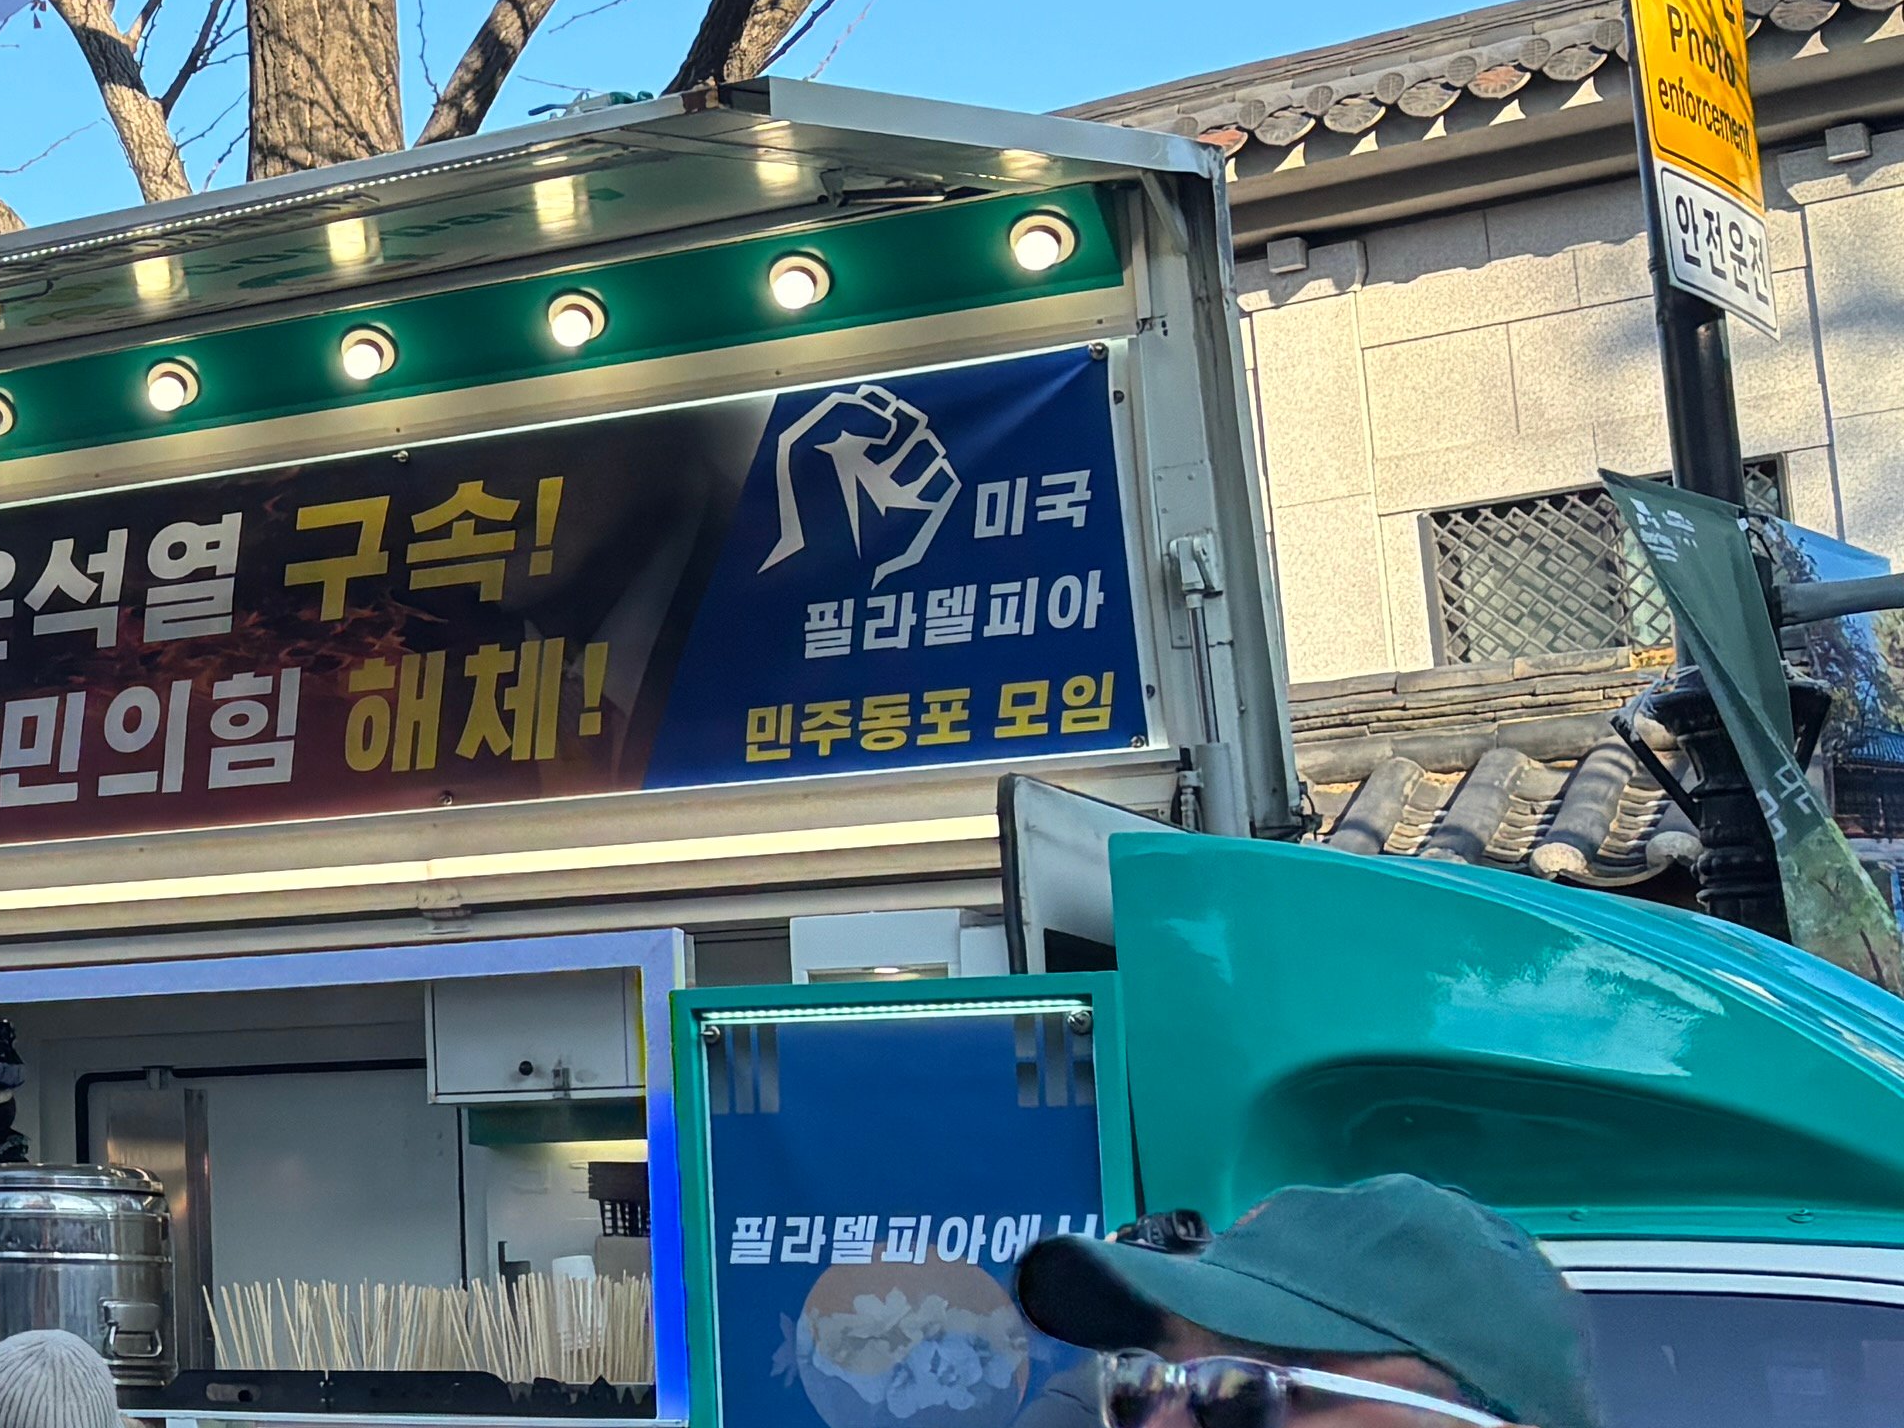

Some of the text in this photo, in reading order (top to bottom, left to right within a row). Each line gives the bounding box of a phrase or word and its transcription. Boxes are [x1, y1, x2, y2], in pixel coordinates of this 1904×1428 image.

[1666, 3, 1737, 89] Photo
[1657, 76, 1752, 161] enforcement
[1674, 194, 1770, 307] 안전운전
[281, 474, 565, 624] 구속!
[975, 467, 1094, 541] 미국
[803, 571, 1105, 661] 필라델피아
[342, 638, 604, 777] 해체!
[743, 670, 1116, 763] 민주동포 모임
